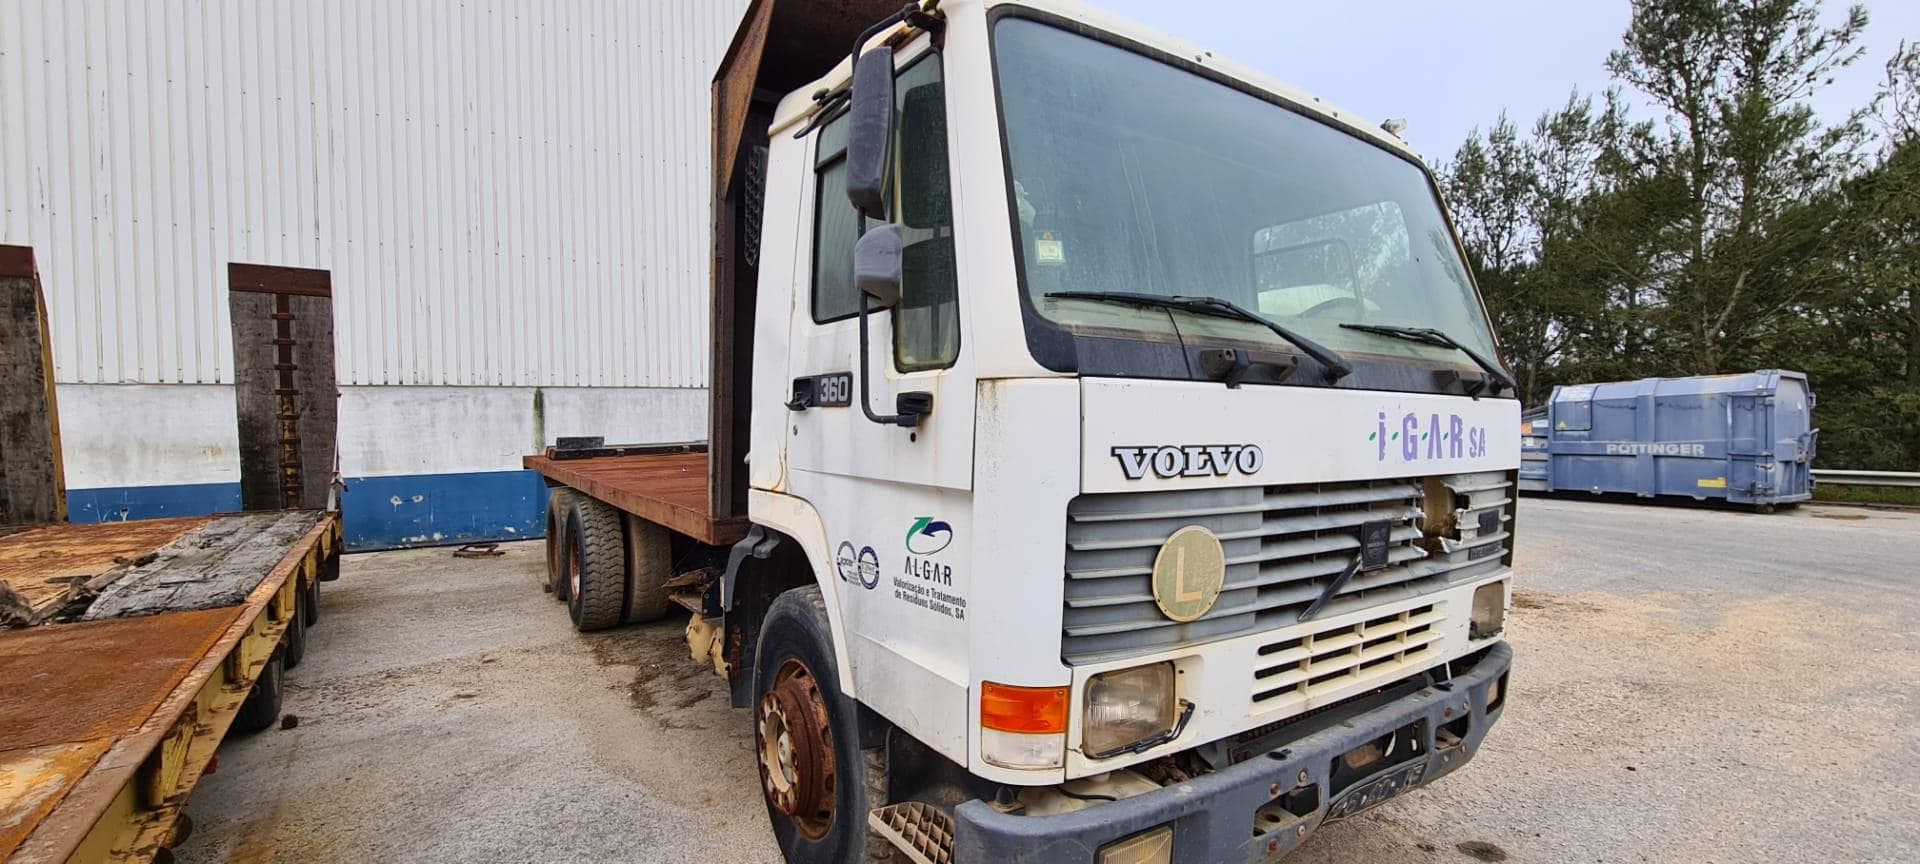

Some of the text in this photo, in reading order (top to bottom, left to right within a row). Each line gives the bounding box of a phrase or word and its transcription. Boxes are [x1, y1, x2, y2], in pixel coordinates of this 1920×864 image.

[820, 376, 849, 402] 360
[1469, 426, 1486, 458] SA
[1112, 444, 1264, 480] VOLVO
[1175, 545, 1204, 603] L
[893, 576, 967, 608] Valorização e Tratamento
[894, 588, 902, 600] de
[902, 590, 929, 609] Resíduos
[955, 607, 965, 621] SA
